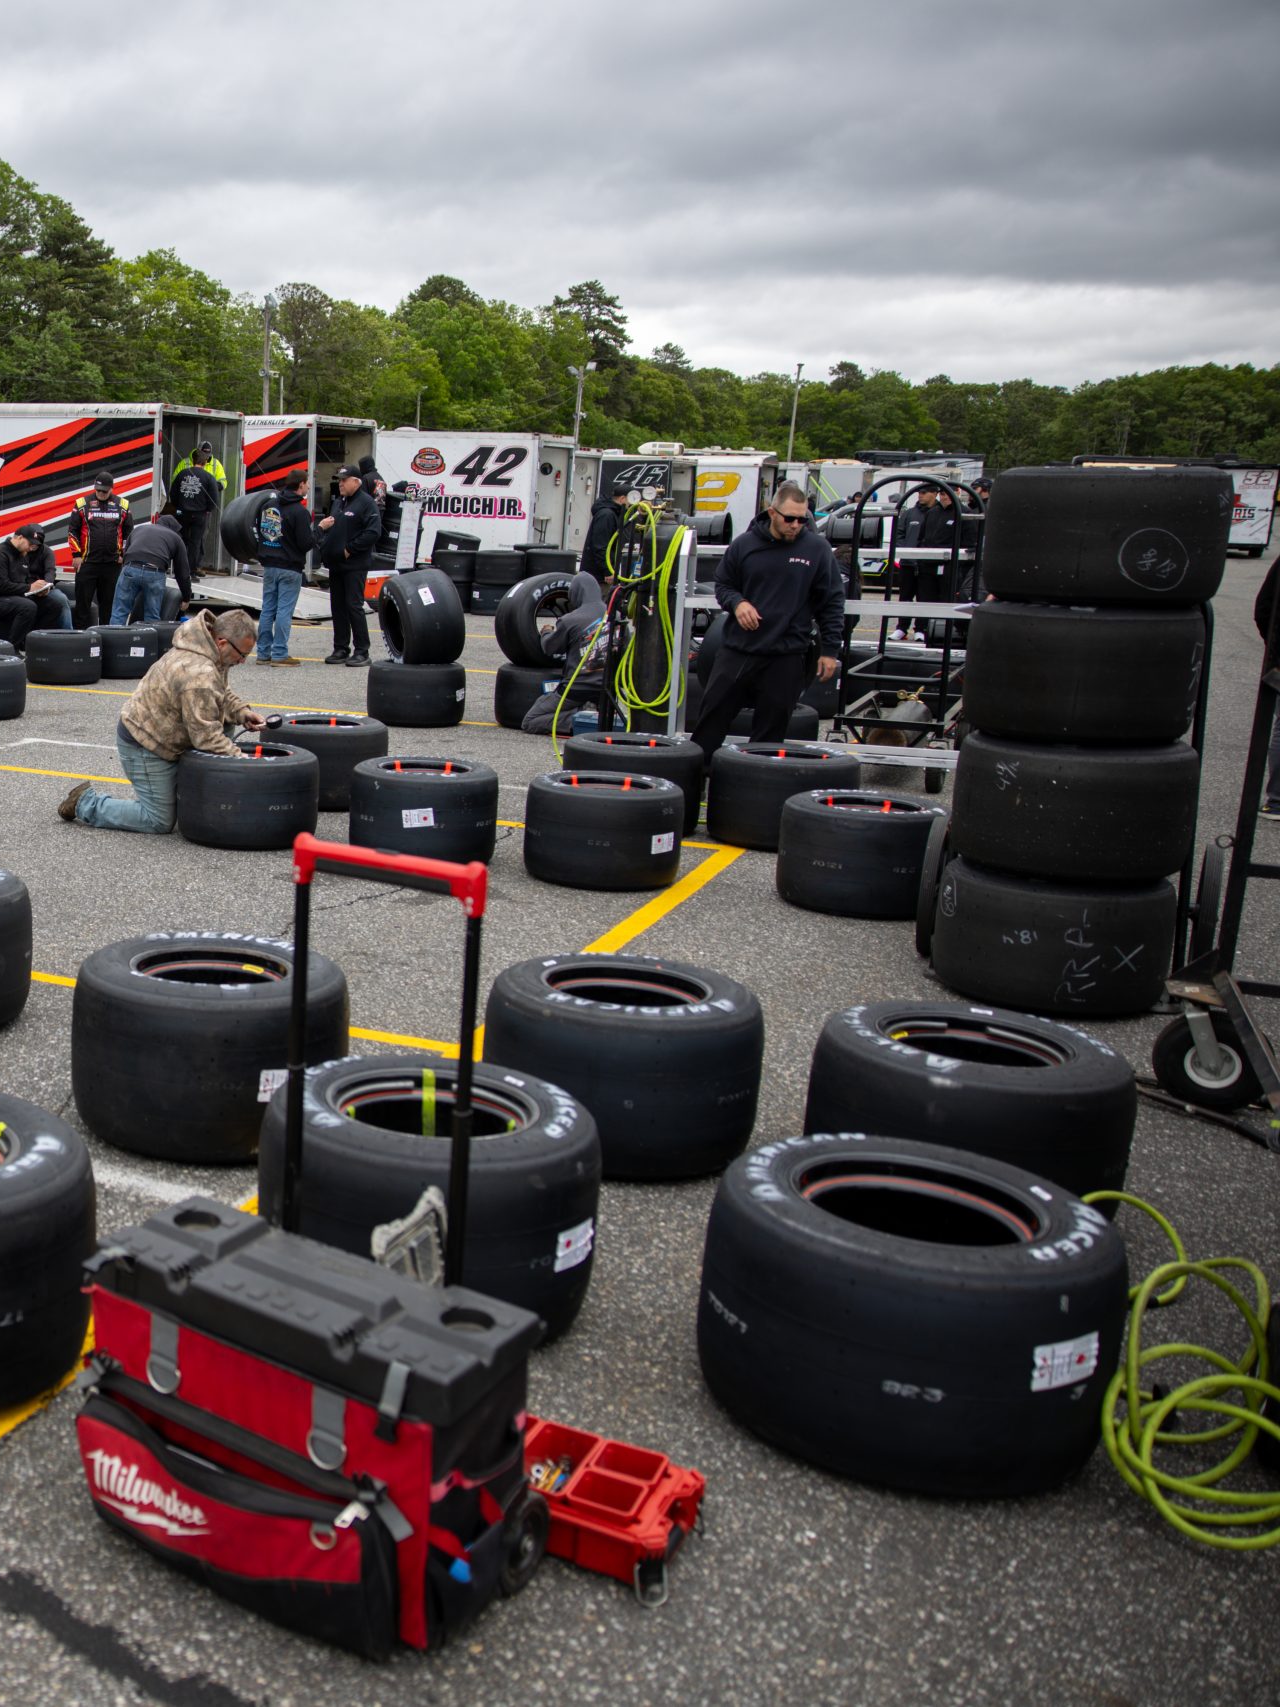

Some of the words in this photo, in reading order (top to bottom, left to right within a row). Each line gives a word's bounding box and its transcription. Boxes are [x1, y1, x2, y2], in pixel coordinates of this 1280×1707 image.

[451, 446, 529, 486] 42
[613, 463, 669, 489] 46
[1242, 470, 1275, 486] 52
[426, 496, 494, 516] MICICH
[532, 580, 572, 601] RACER
[145, 930, 296, 951] AMERICA
[743, 1131, 867, 1201] AMERICAN
[1026, 1202, 1108, 1262] RACER
[86, 1448, 208, 1526] Milwaukee
